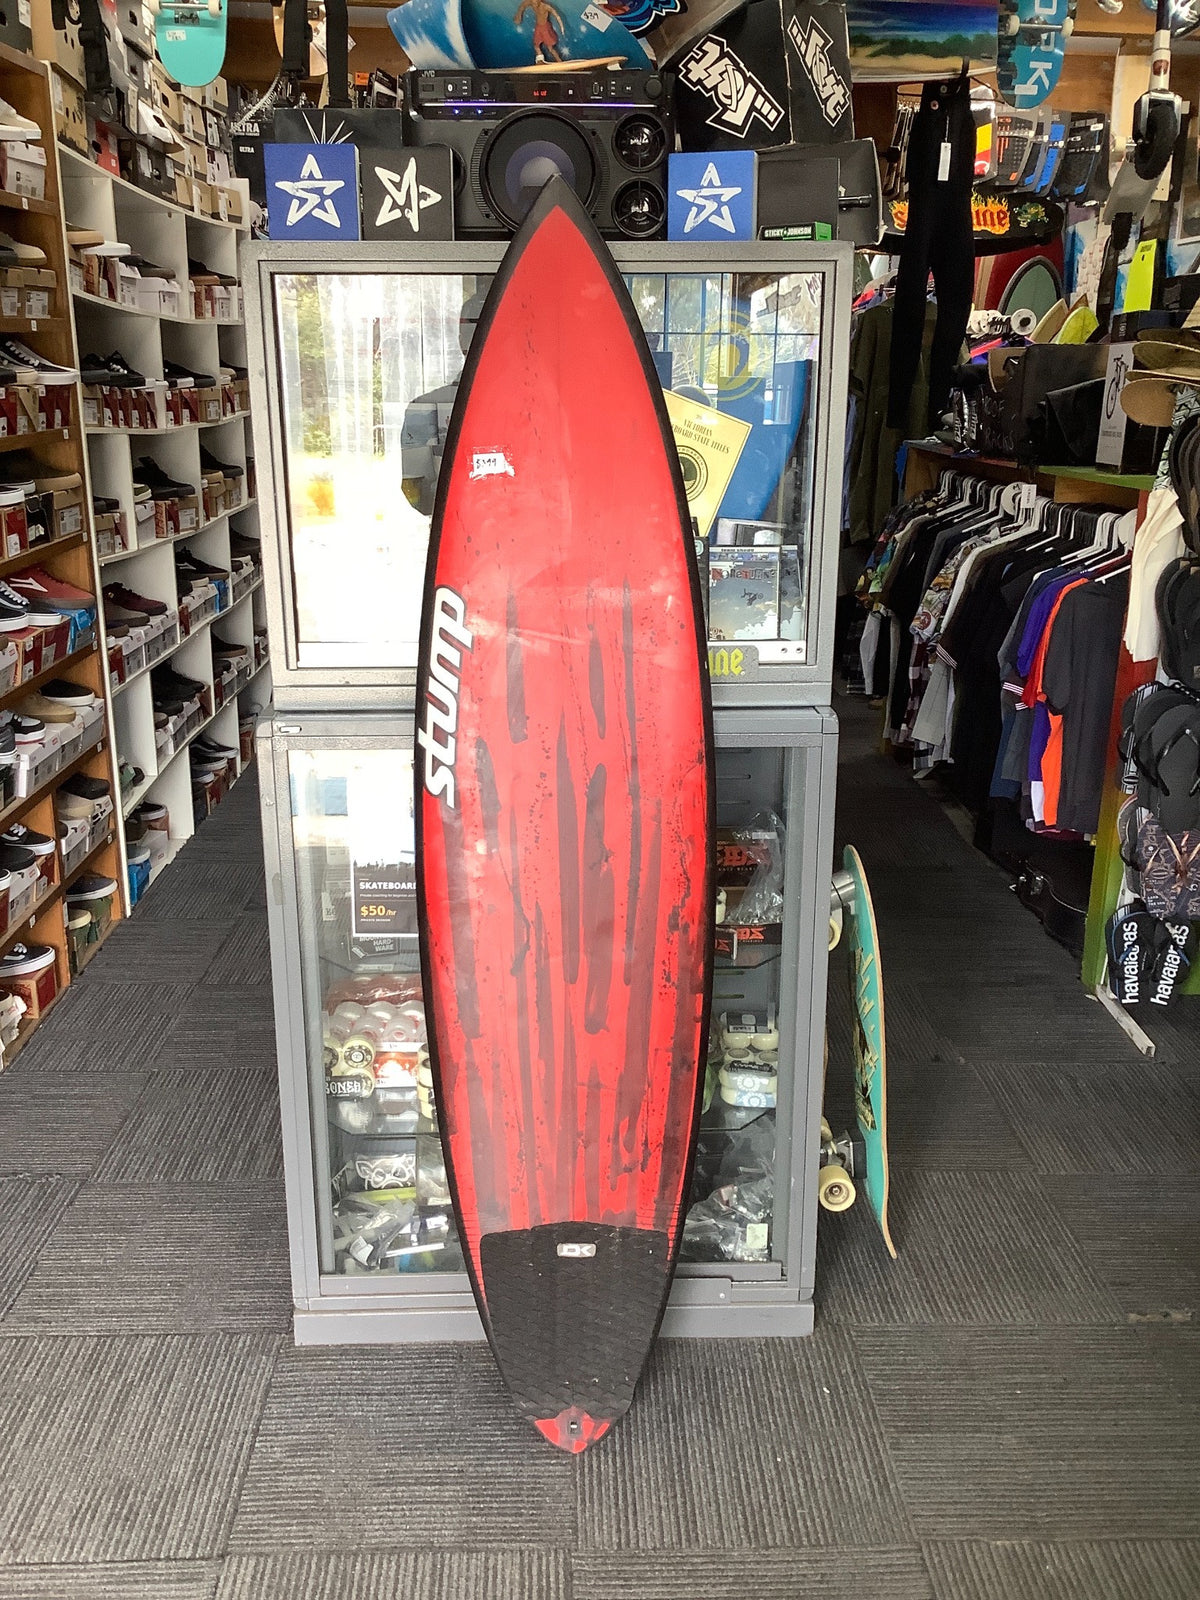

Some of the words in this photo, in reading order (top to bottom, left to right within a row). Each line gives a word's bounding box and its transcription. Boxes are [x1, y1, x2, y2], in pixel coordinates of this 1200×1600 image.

[421, 70, 436, 78] JVC
[764, 229, 783, 238] STICKY
[787, 226, 812, 236] JOHNSON
[683, 419, 713, 437] VICTORIAN
[692, 434, 711, 448] STATE
[418, 586, 474, 809] stump
